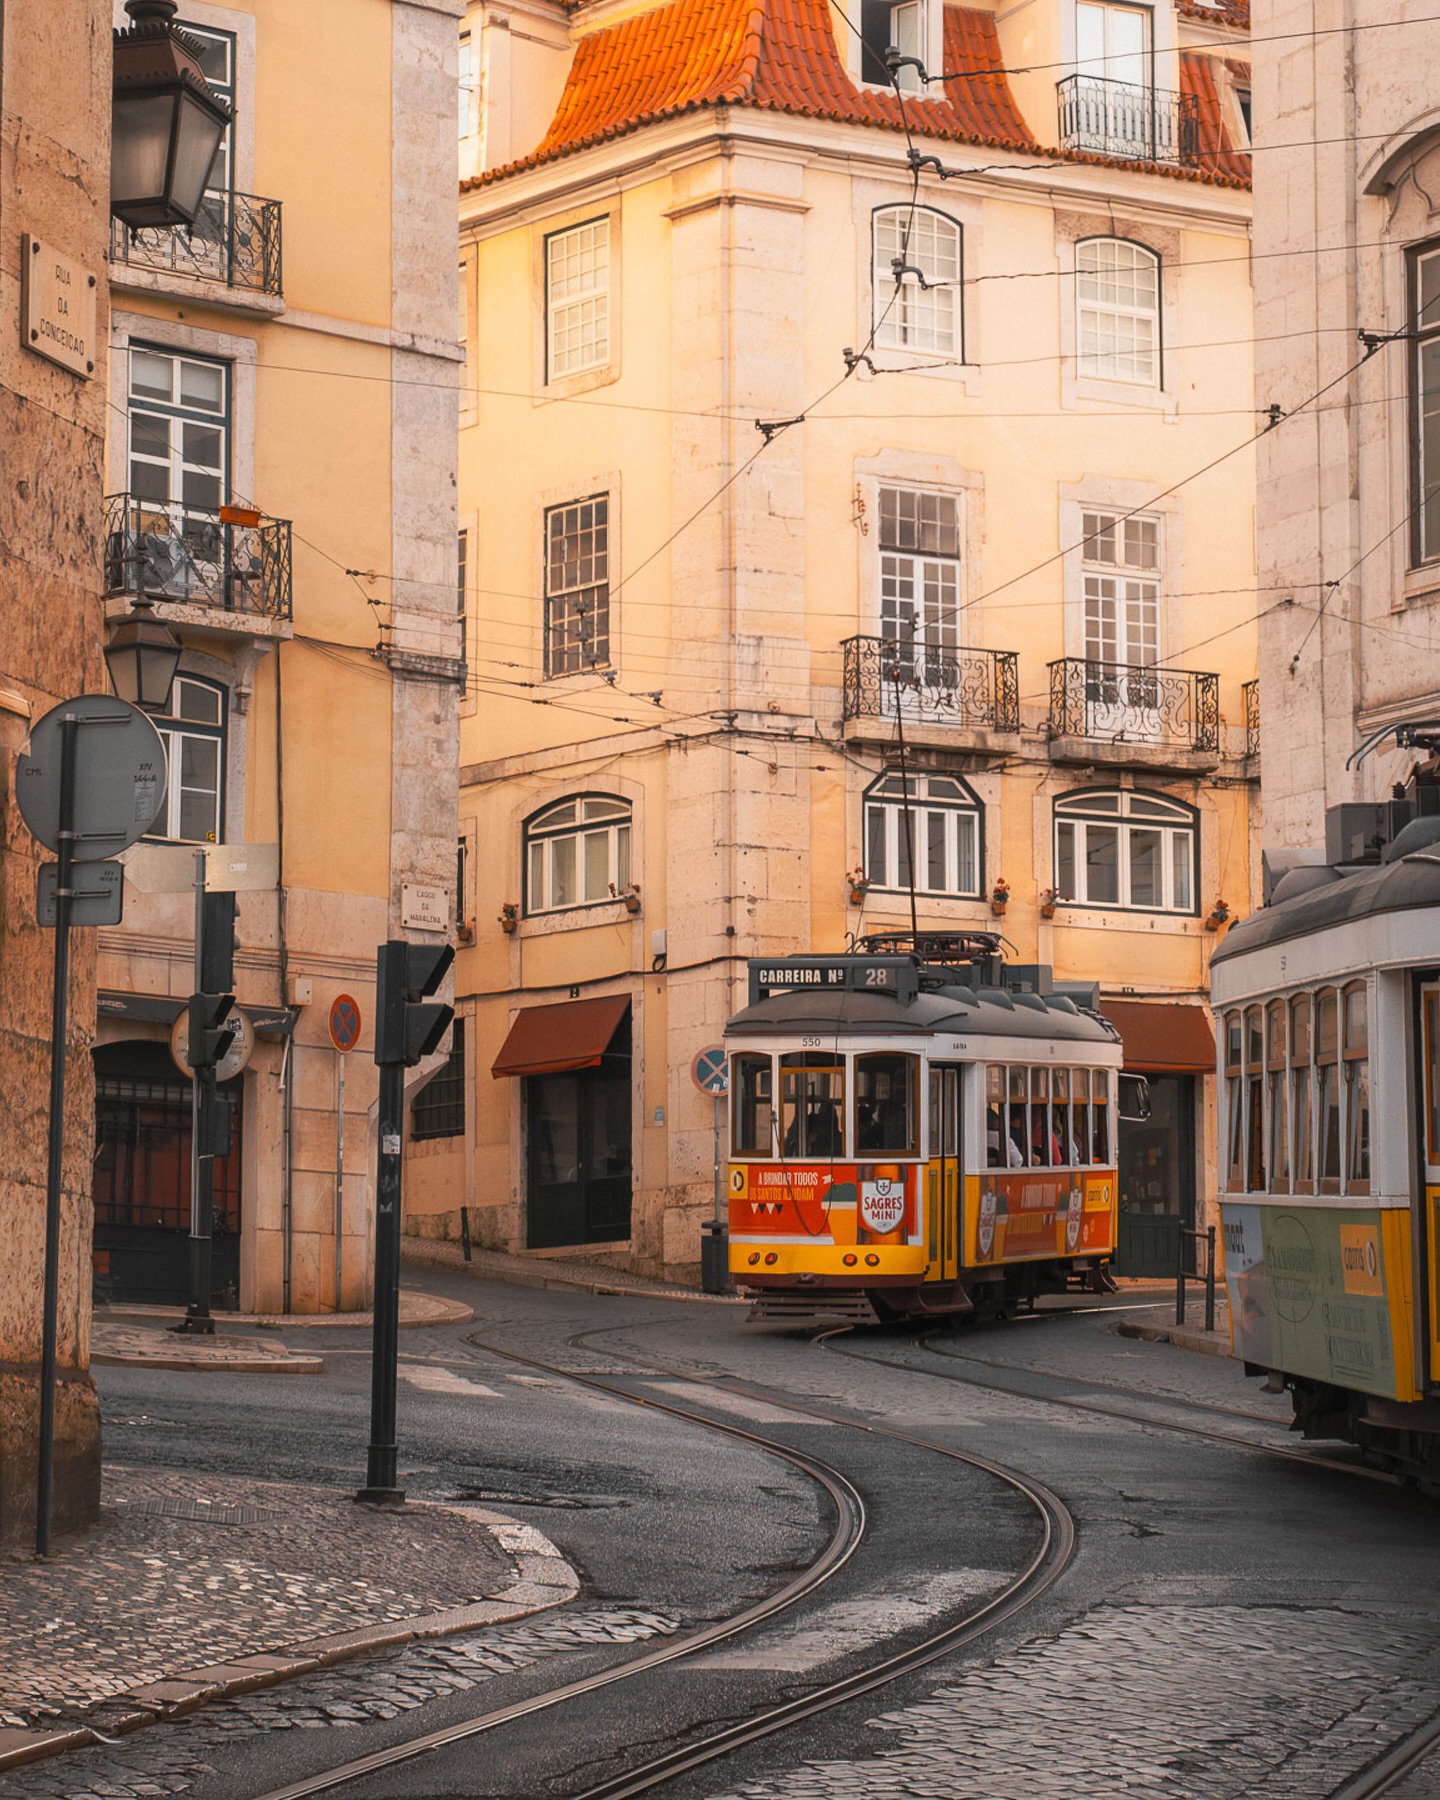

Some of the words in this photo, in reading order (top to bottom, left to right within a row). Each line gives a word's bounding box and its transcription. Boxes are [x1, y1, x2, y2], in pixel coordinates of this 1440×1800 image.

[55, 264, 71, 287] RUA
[57, 296, 68, 316] DA
[759, 969, 821, 983] CARREIRA
[865, 968, 887, 986] 28
[802, 1038, 821, 1047] 550
[794, 1172, 818, 1186] TODOS
[864, 1196, 902, 1211] SAGRES
